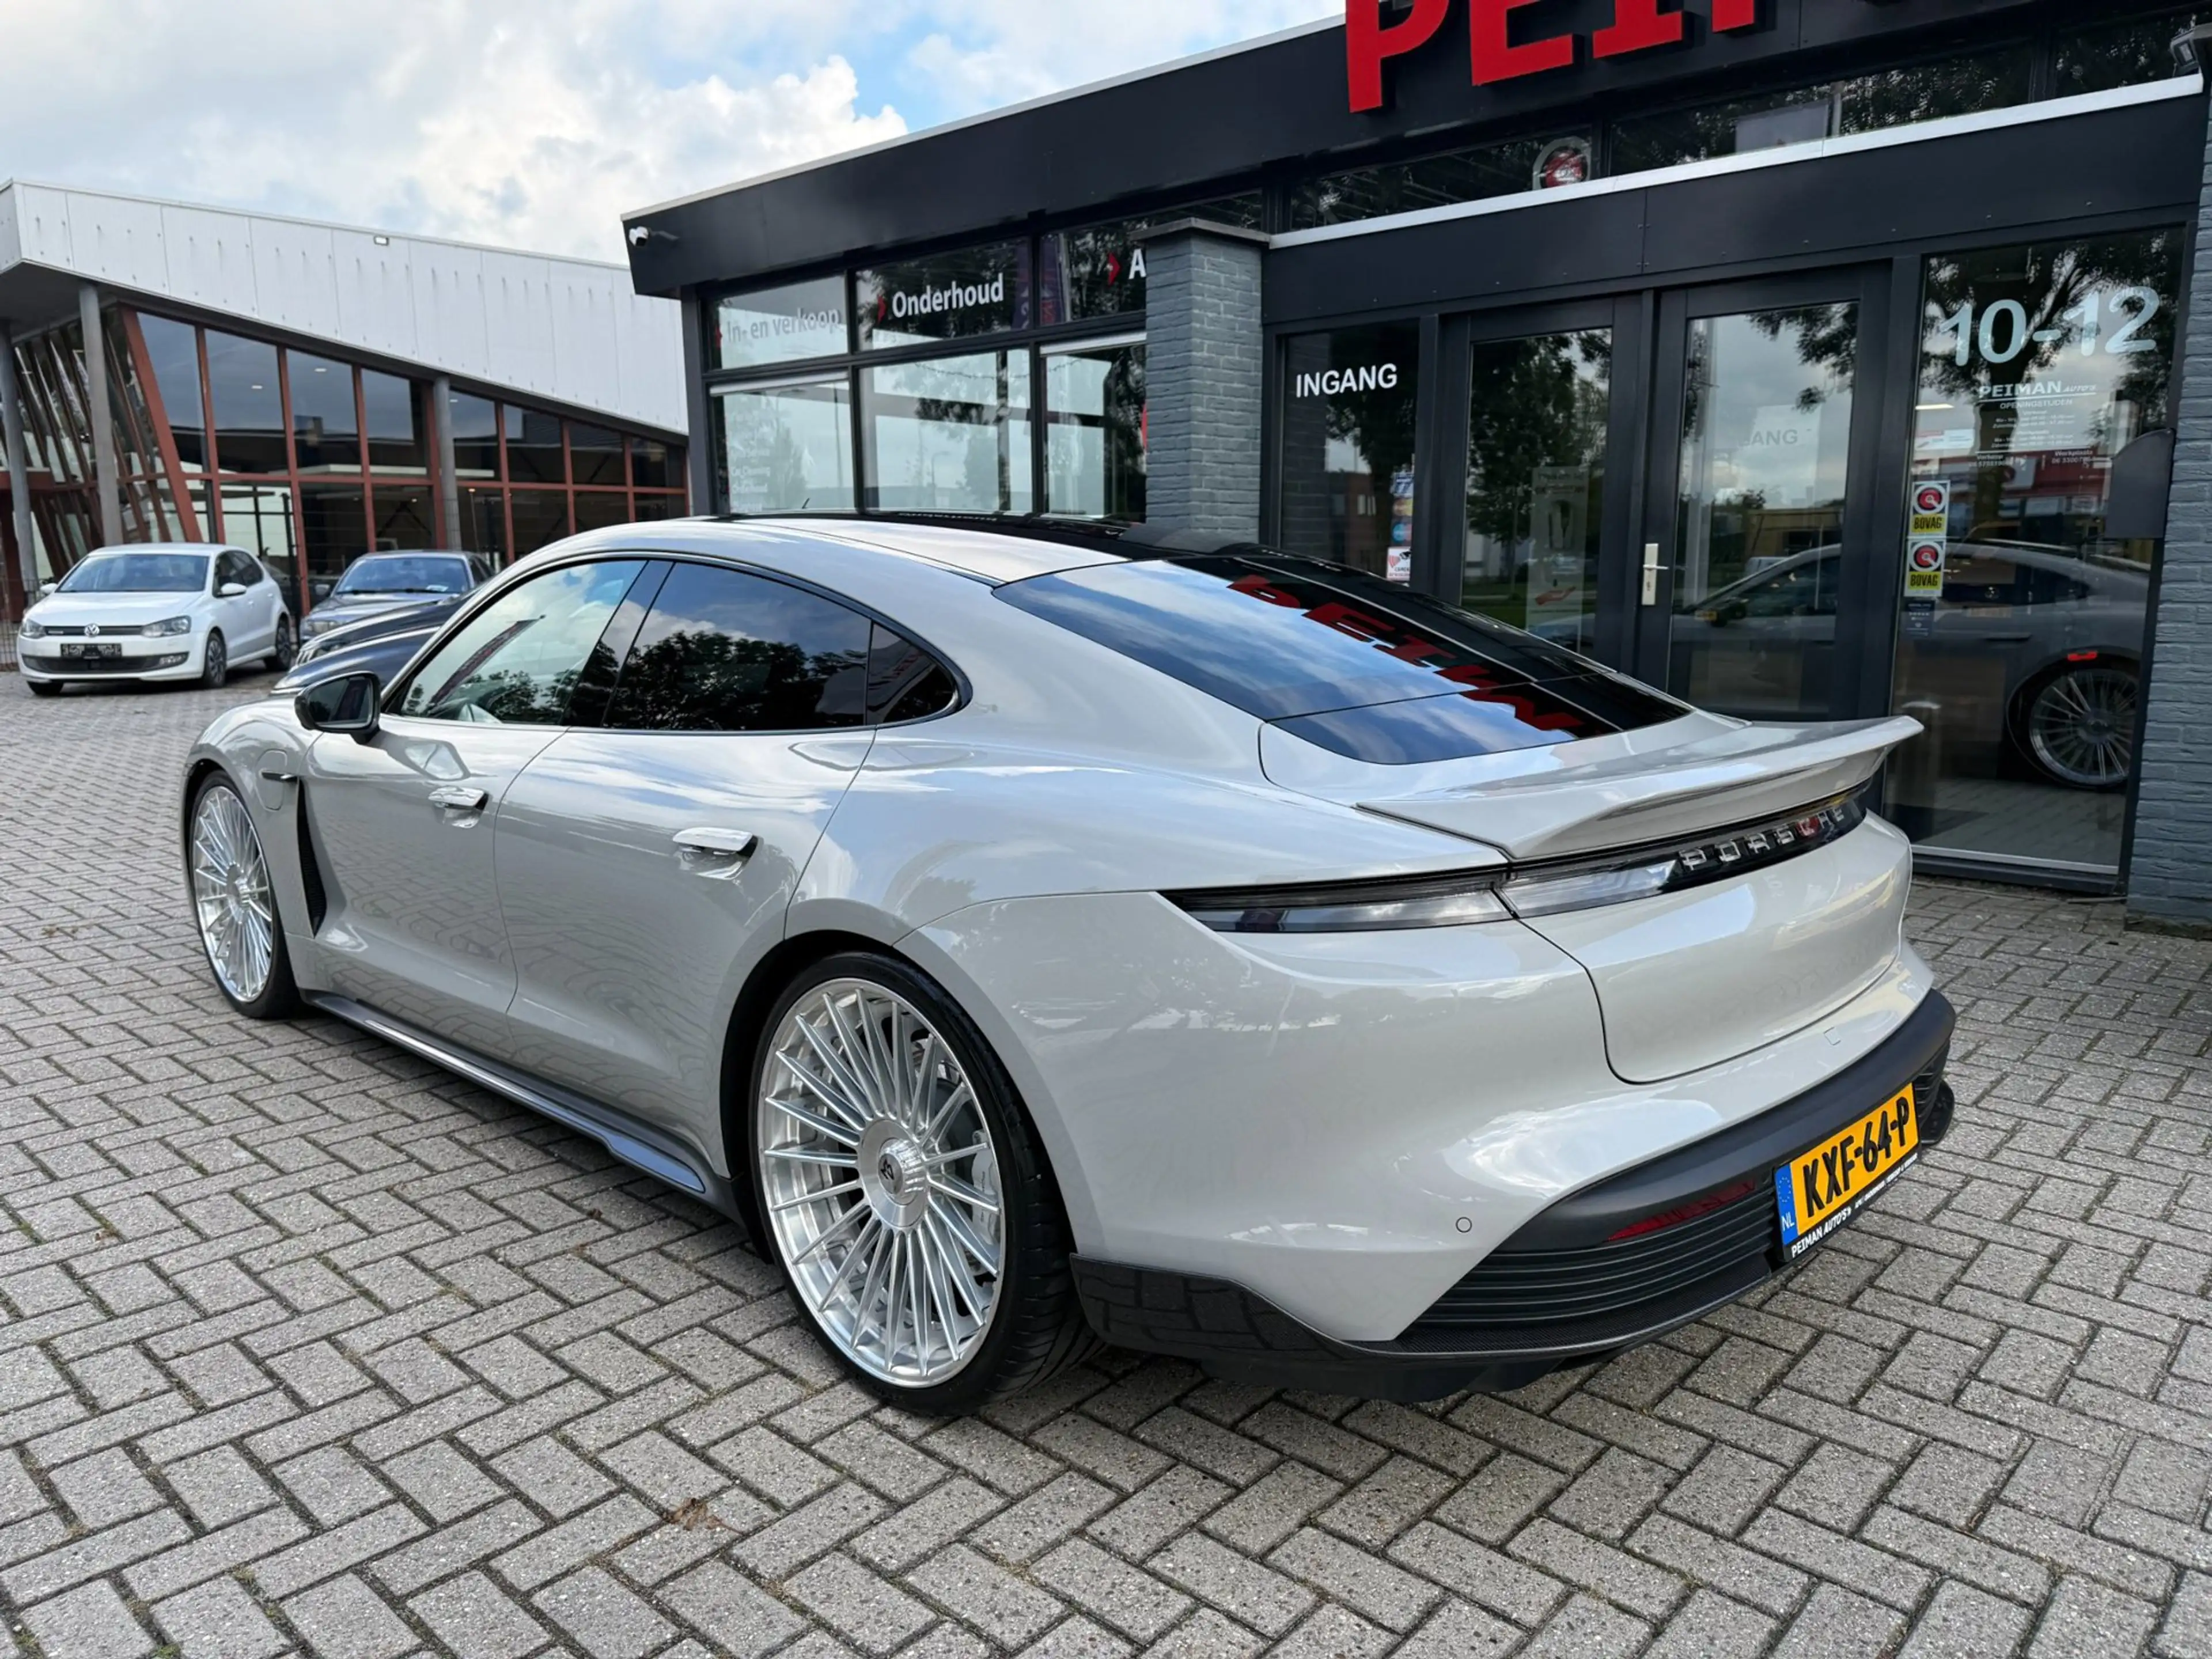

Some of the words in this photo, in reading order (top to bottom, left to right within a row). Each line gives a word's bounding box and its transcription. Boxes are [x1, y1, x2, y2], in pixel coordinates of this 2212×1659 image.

[892, 272, 1004, 318] Onderhoud
[750, 320, 768, 339] en
[772, 307, 841, 336] verkoop
[1938, 286, 2160, 366] 10-12
[1296, 363, 1398, 399] INGANG
[1978, 380, 2062, 398] PEIMAN
[1914, 517, 1942, 529] BOVAG
[1910, 574, 1938, 586] BOVAG
[1679, 808, 1845, 871] PORSCHE
[1802, 1096, 1910, 1218] KXF-64-P
[1781, 1211, 1795, 1232] NL
[1791, 1225, 1823, 1258] PEIMAN
